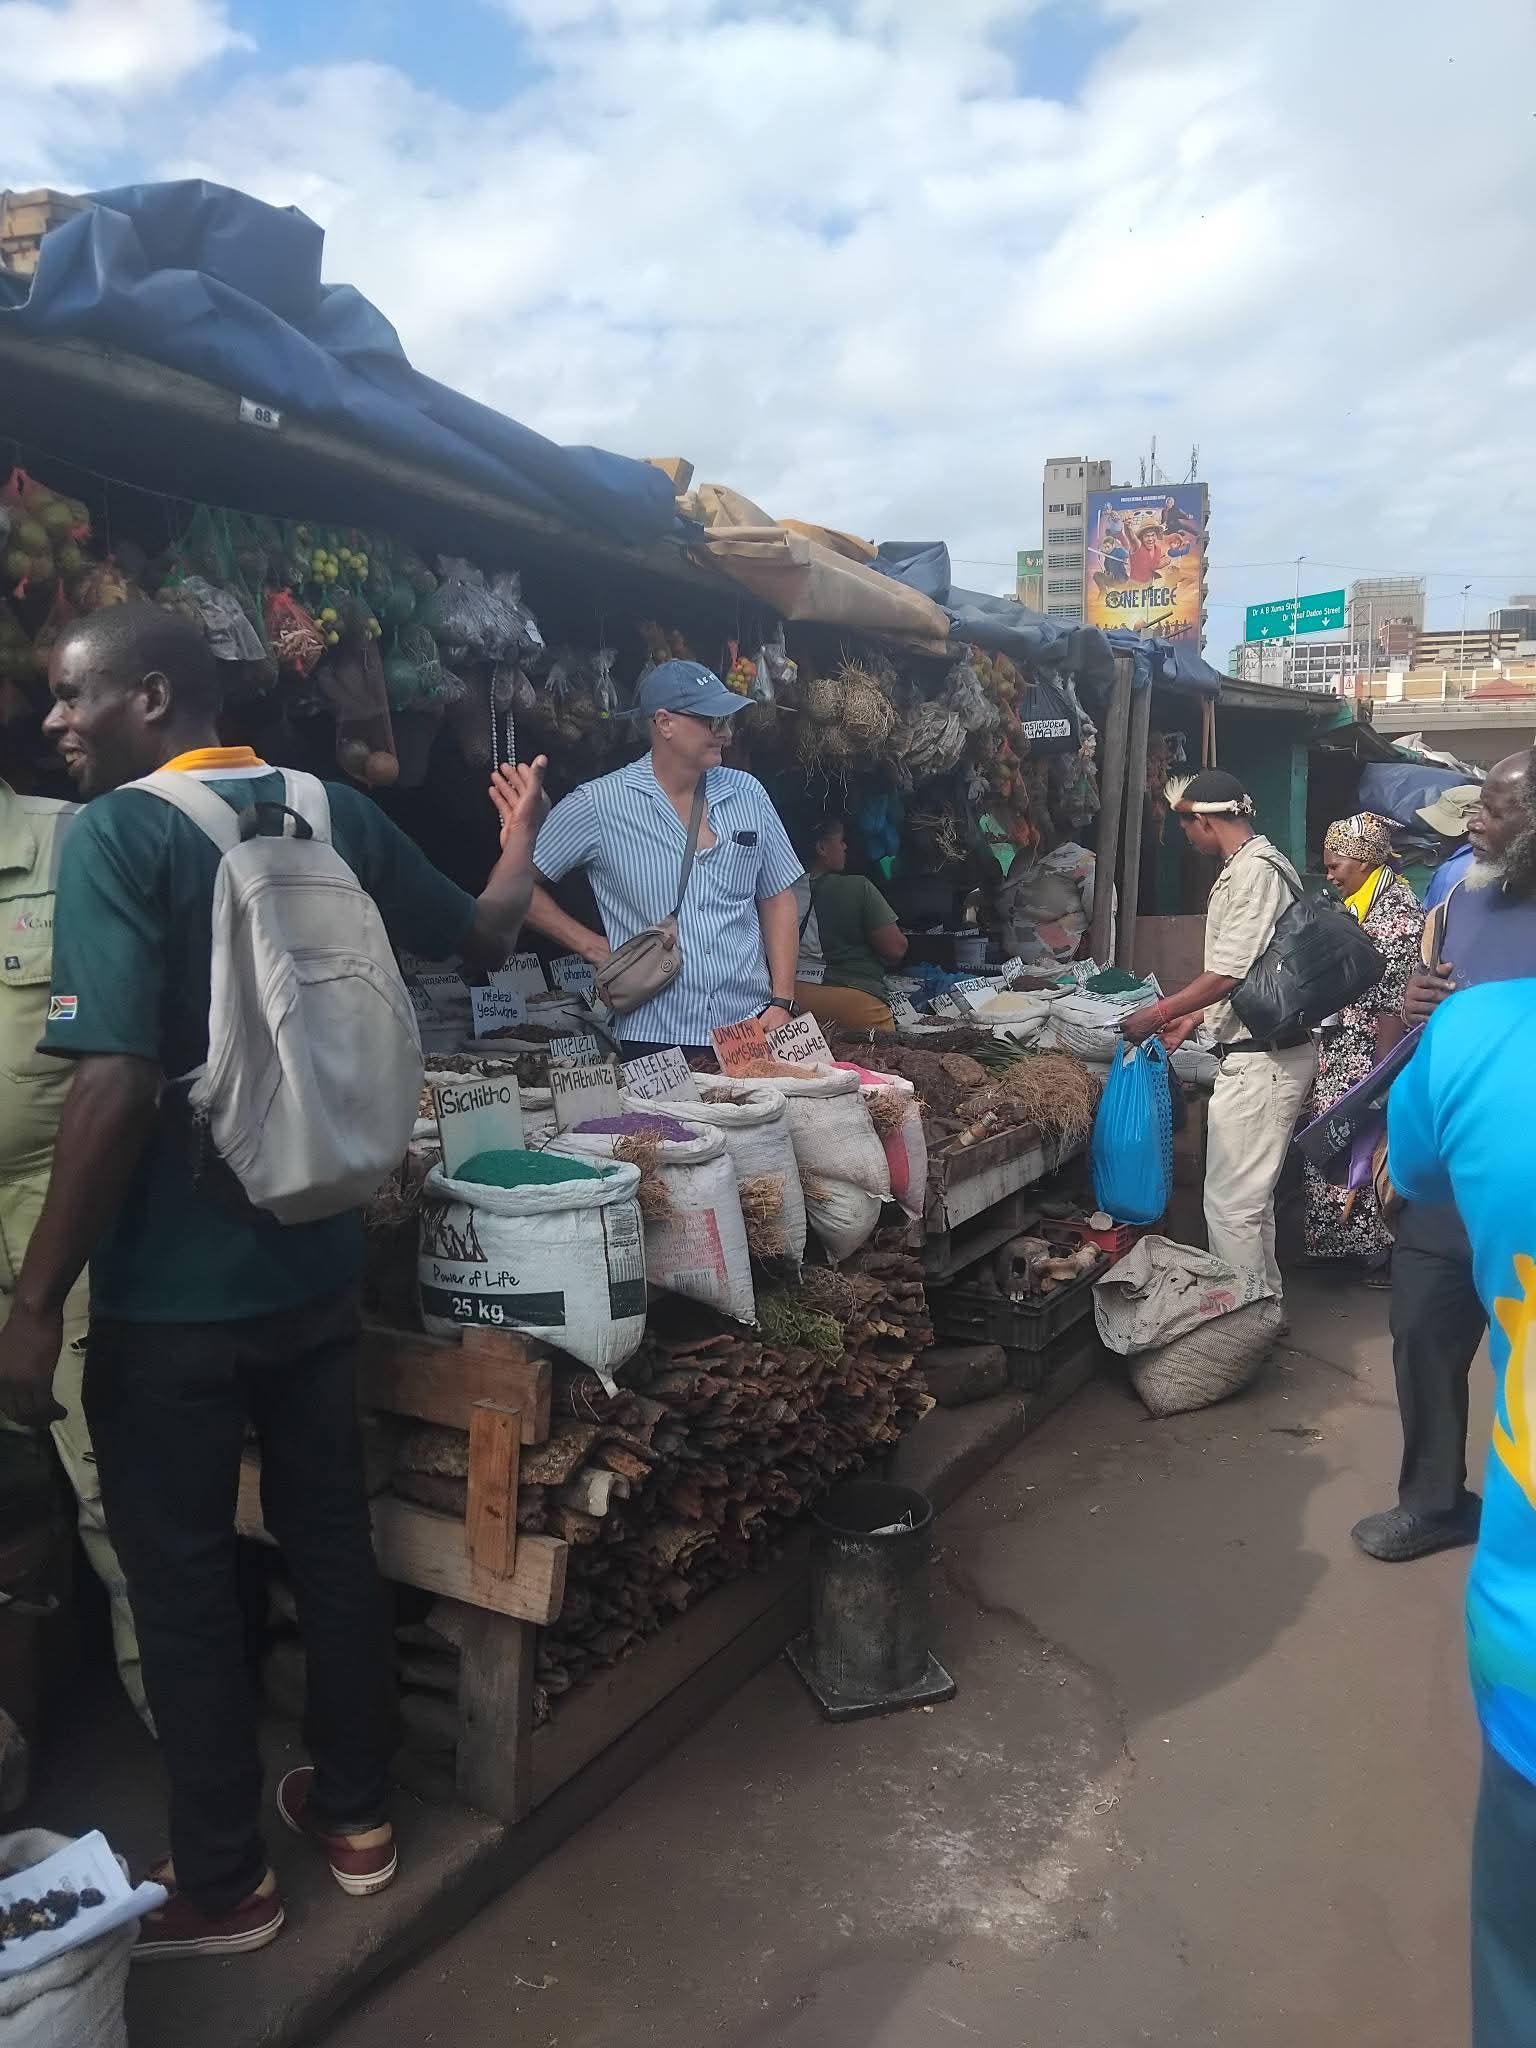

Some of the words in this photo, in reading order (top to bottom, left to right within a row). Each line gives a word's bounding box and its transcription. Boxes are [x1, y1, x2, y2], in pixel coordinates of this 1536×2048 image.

[1105, 588, 1140, 609] ONE
[1141, 586, 1178, 608] PIECE
[1252, 608, 1259, 617] Dr
[1260, 607, 1265, 615] A
[1265, 606, 1270, 614] B
[1282, 613, 1289, 621] Dr
[1291, 611, 1305, 621] Ysuf
[1324, 606, 1341, 615] Street
[432, 1263, 466, 1284] Power
[468, 1271, 482, 1287] of
[484, 1269, 521, 1288] Life
[452, 1296, 473, 1318] 25
[478, 1299, 505, 1325] kg
